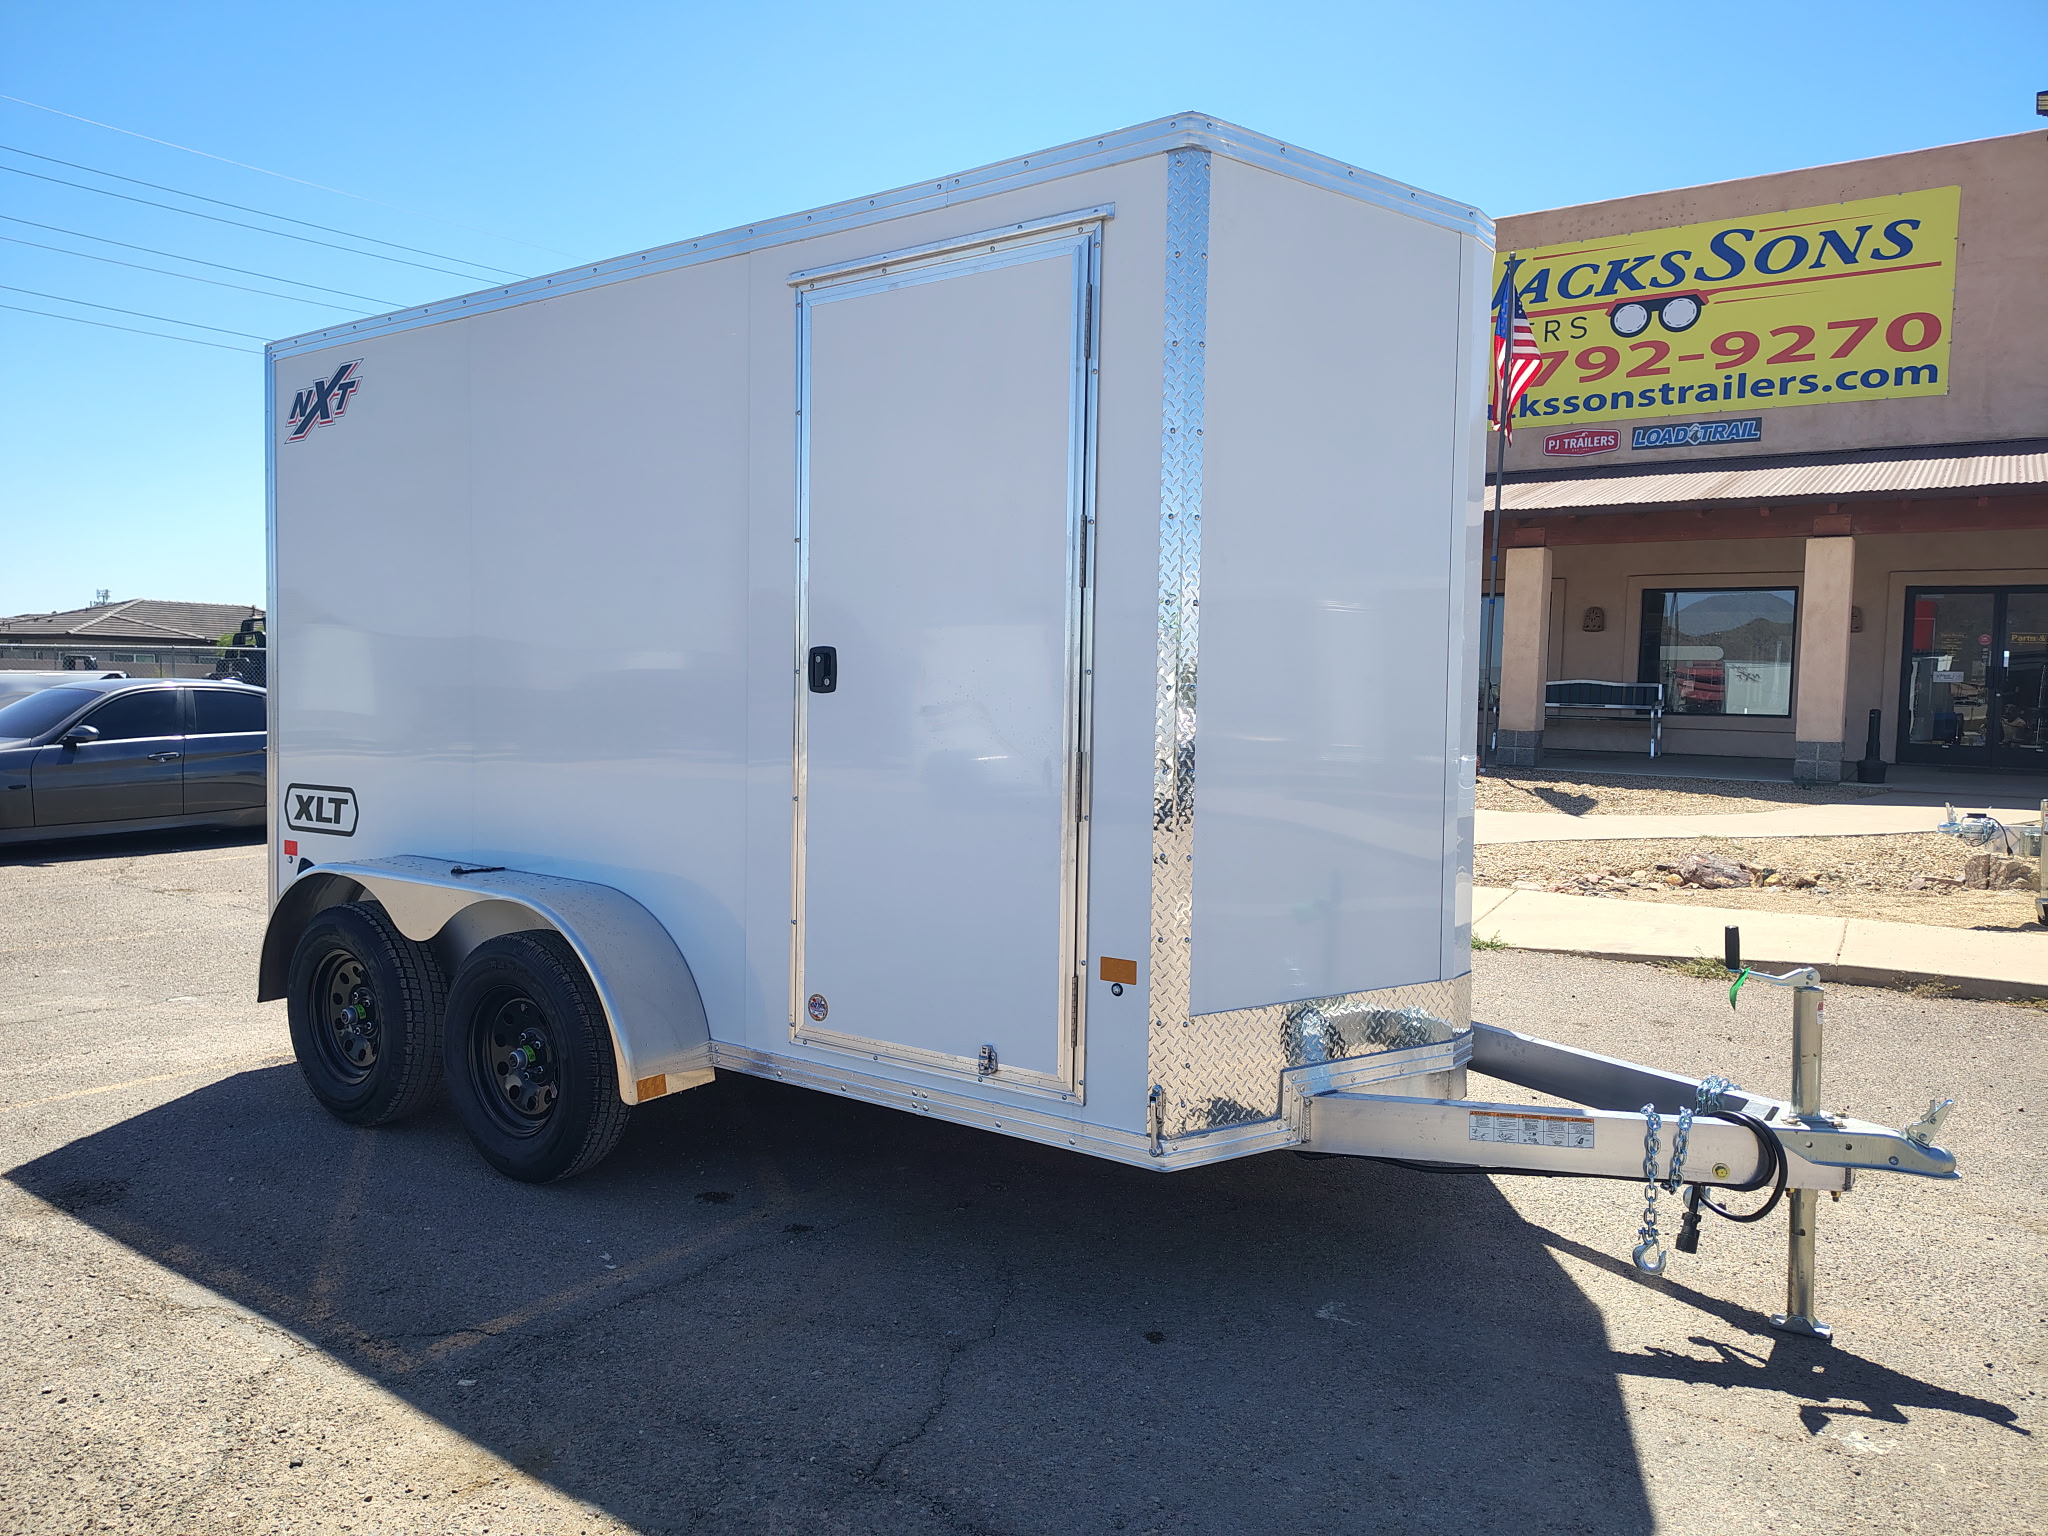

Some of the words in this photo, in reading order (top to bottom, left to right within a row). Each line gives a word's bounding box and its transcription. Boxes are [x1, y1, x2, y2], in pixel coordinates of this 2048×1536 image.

[287, 360, 361, 441] NXT
[1548, 439, 1560, 451] PJ
[1563, 435, 1615, 449] TRAILERS
[1634, 428, 1689, 448] LOAD
[1700, 421, 1760, 441] TRAIL
[2011, 634, 2036, 642] Parts
[293, 794, 349, 825] XLT
